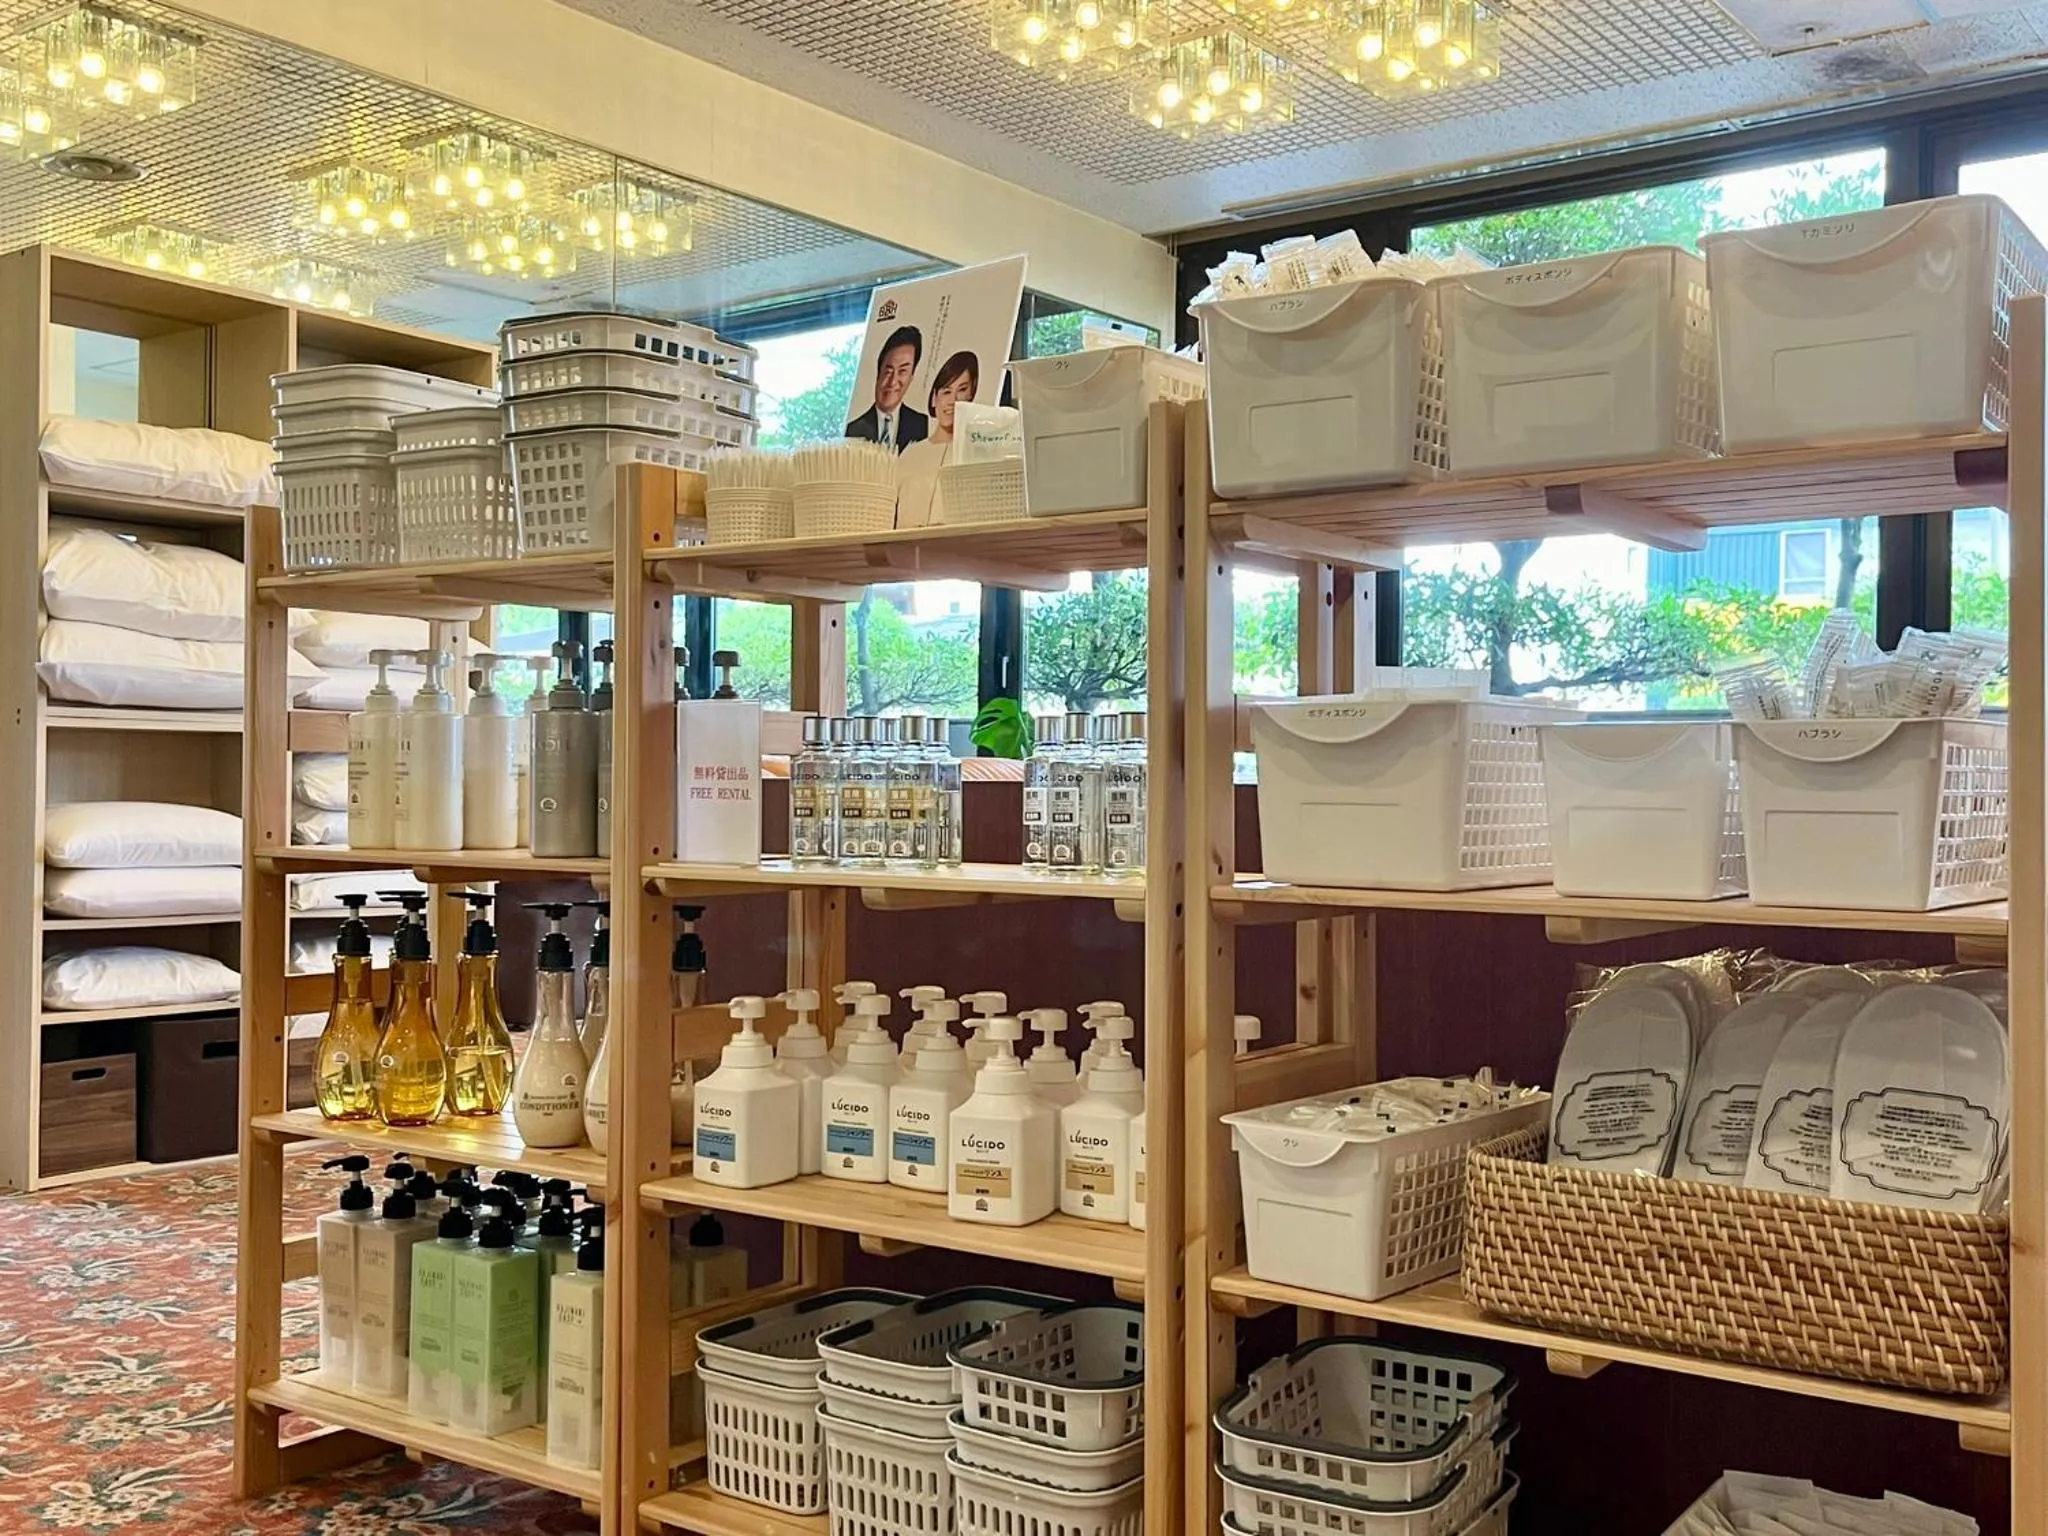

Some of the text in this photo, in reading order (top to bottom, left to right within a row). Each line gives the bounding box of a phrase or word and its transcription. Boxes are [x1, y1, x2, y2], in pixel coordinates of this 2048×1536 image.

[1798, 728, 1842, 739] ハブラシ
[693, 766, 749, 780] 無料貸出品
[690, 787, 752, 801] FREE RENTAL
[961, 1133, 1006, 1151] LÚCIDO
